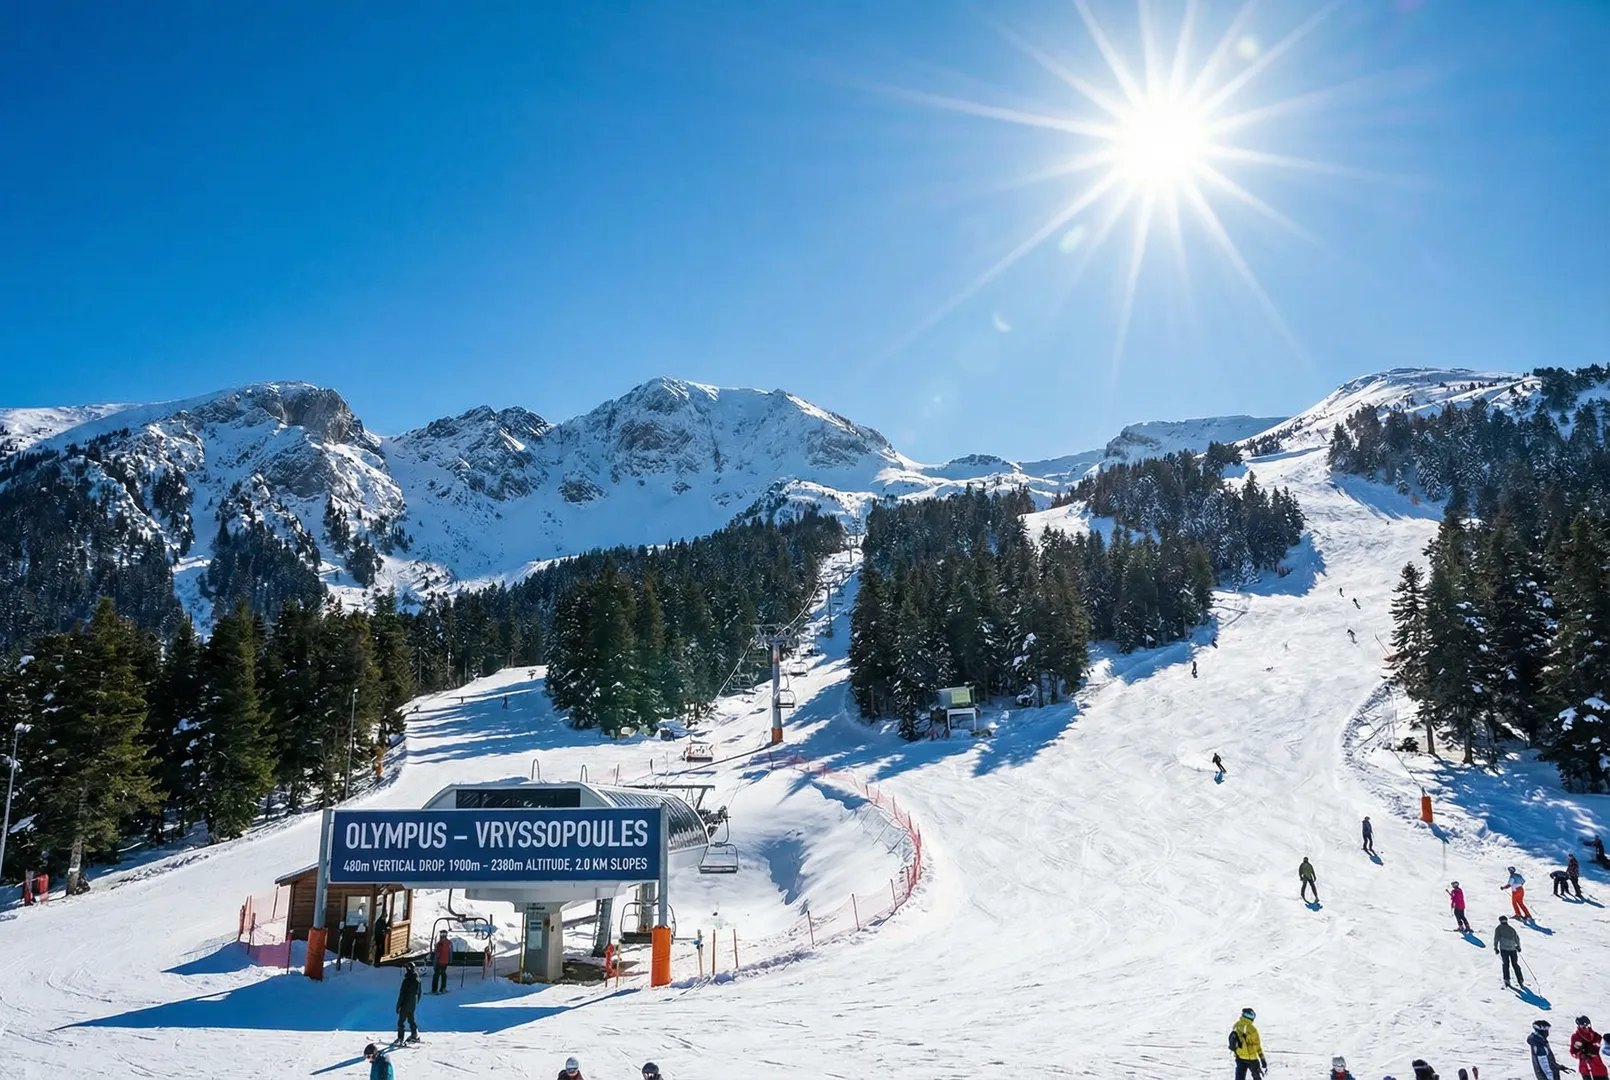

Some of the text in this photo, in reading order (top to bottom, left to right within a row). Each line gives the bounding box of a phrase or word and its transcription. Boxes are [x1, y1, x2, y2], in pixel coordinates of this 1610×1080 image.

[345, 821, 448, 850] OLYMPUS
[475, 819, 648, 848] VRYSSOPOULES
[343, 859, 370, 873] 480m
[372, 859, 417, 872] VERTICAL
[448, 858, 481, 872] 1900m
[490, 858, 524, 872] 2380m
[525, 858, 573, 872] ALTITUDE,
[575, 857, 591, 871] 2.0
[592, 857, 608, 871] KM
[610, 857, 648, 870] SLOPES
